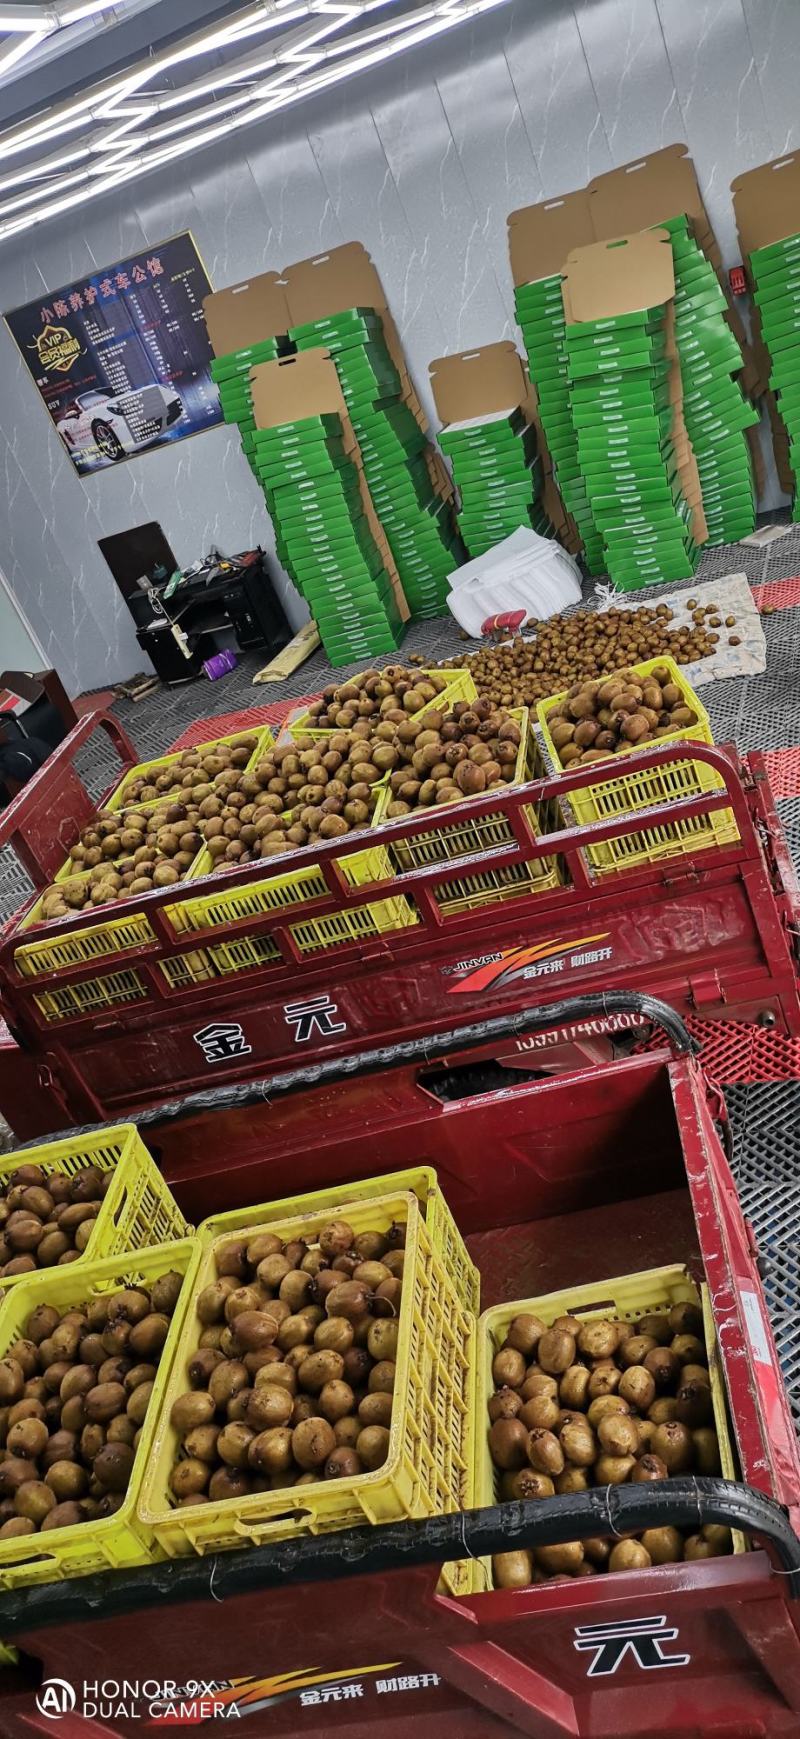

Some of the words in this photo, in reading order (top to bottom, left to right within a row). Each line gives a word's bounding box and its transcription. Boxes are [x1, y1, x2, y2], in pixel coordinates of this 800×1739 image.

[38, 338, 80, 364] 会员福利
[44, 333, 62, 347] VIP
[523, 960, 564, 980] 金元来
[193, 996, 346, 1063] 金元
[573, 1615, 691, 1676] 元
[299, 1684, 364, 1706] 金元来
[375, 1673, 442, 1694] 财路开
